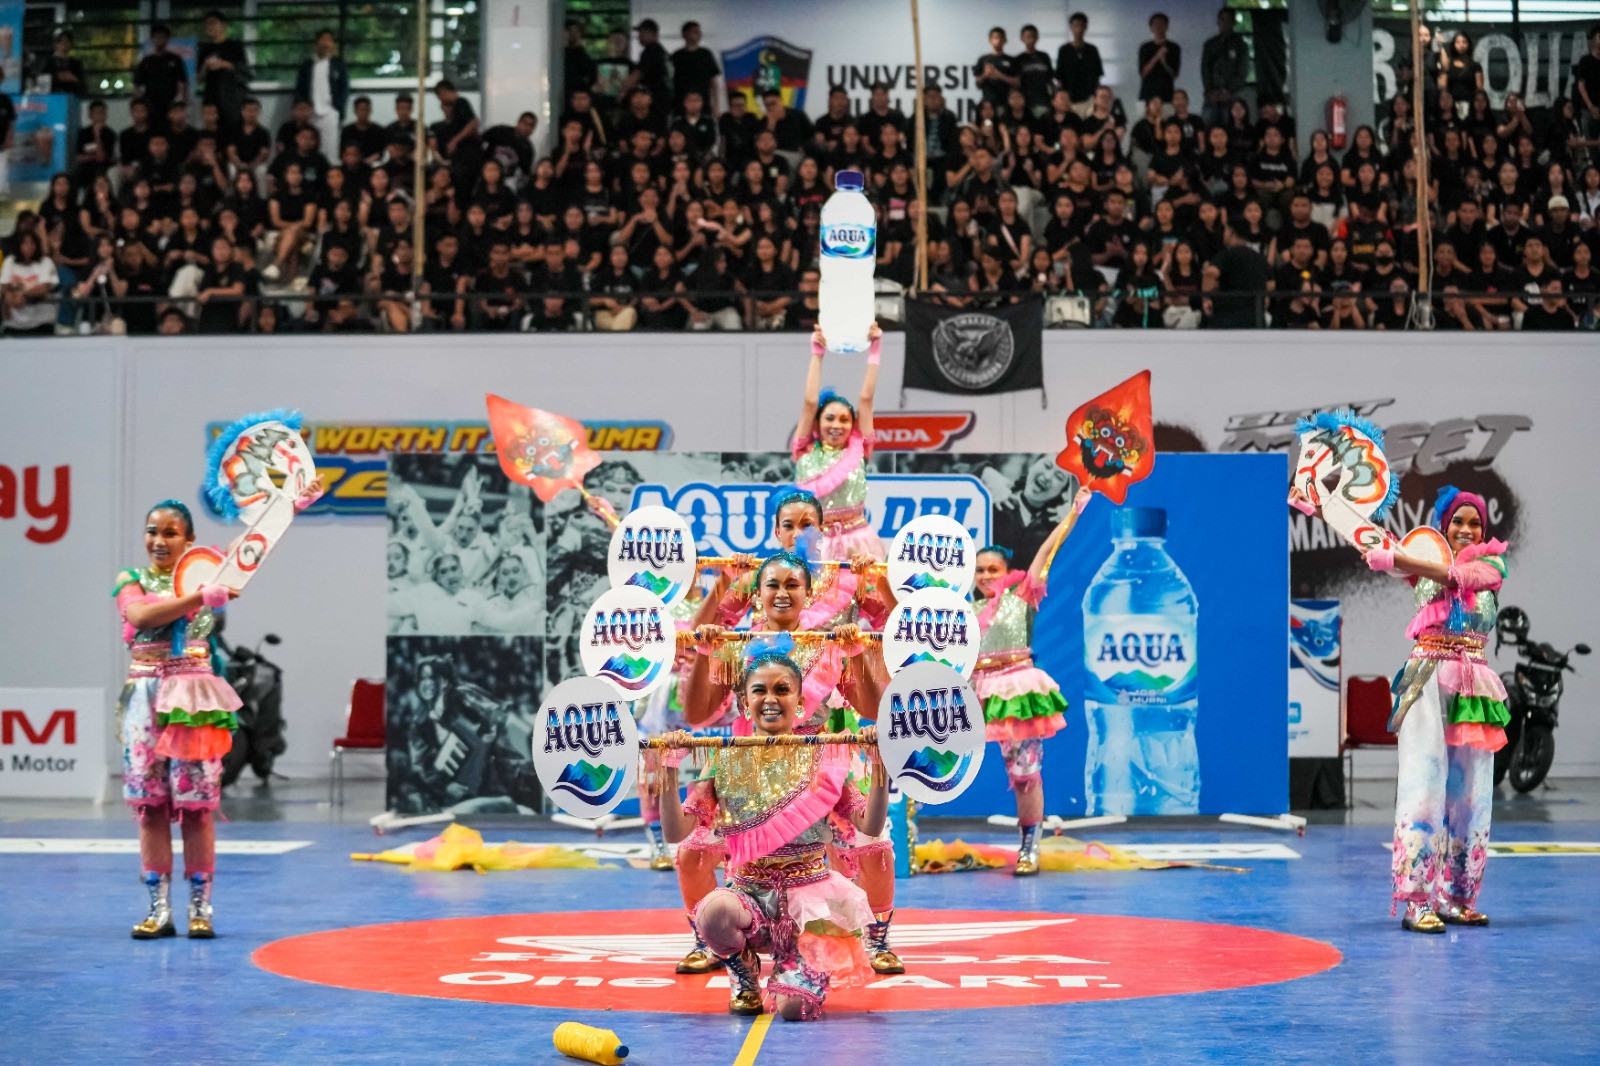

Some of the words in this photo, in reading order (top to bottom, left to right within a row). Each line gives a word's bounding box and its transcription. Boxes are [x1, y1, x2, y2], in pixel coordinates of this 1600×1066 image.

[827, 65, 979, 90] UNIVERSI
[829, 229, 866, 244] AQUA
[315, 427, 447, 454] WORTH
[585, 427, 662, 452] UMA
[876, 428, 931, 442] NDA
[619, 525, 686, 570] AQUA
[897, 531, 966, 571] AQUA
[590, 607, 666, 652] AQUA
[894, 606, 969, 652] AQUA
[1097, 632, 1187, 667] AQUA
[544, 701, 626, 758] AQUA
[889, 687, 972, 744] AQUA
[12, 754, 77, 771] Motor
[471, 951, 1112, 964] HODA
[439, 971, 676, 988] One
